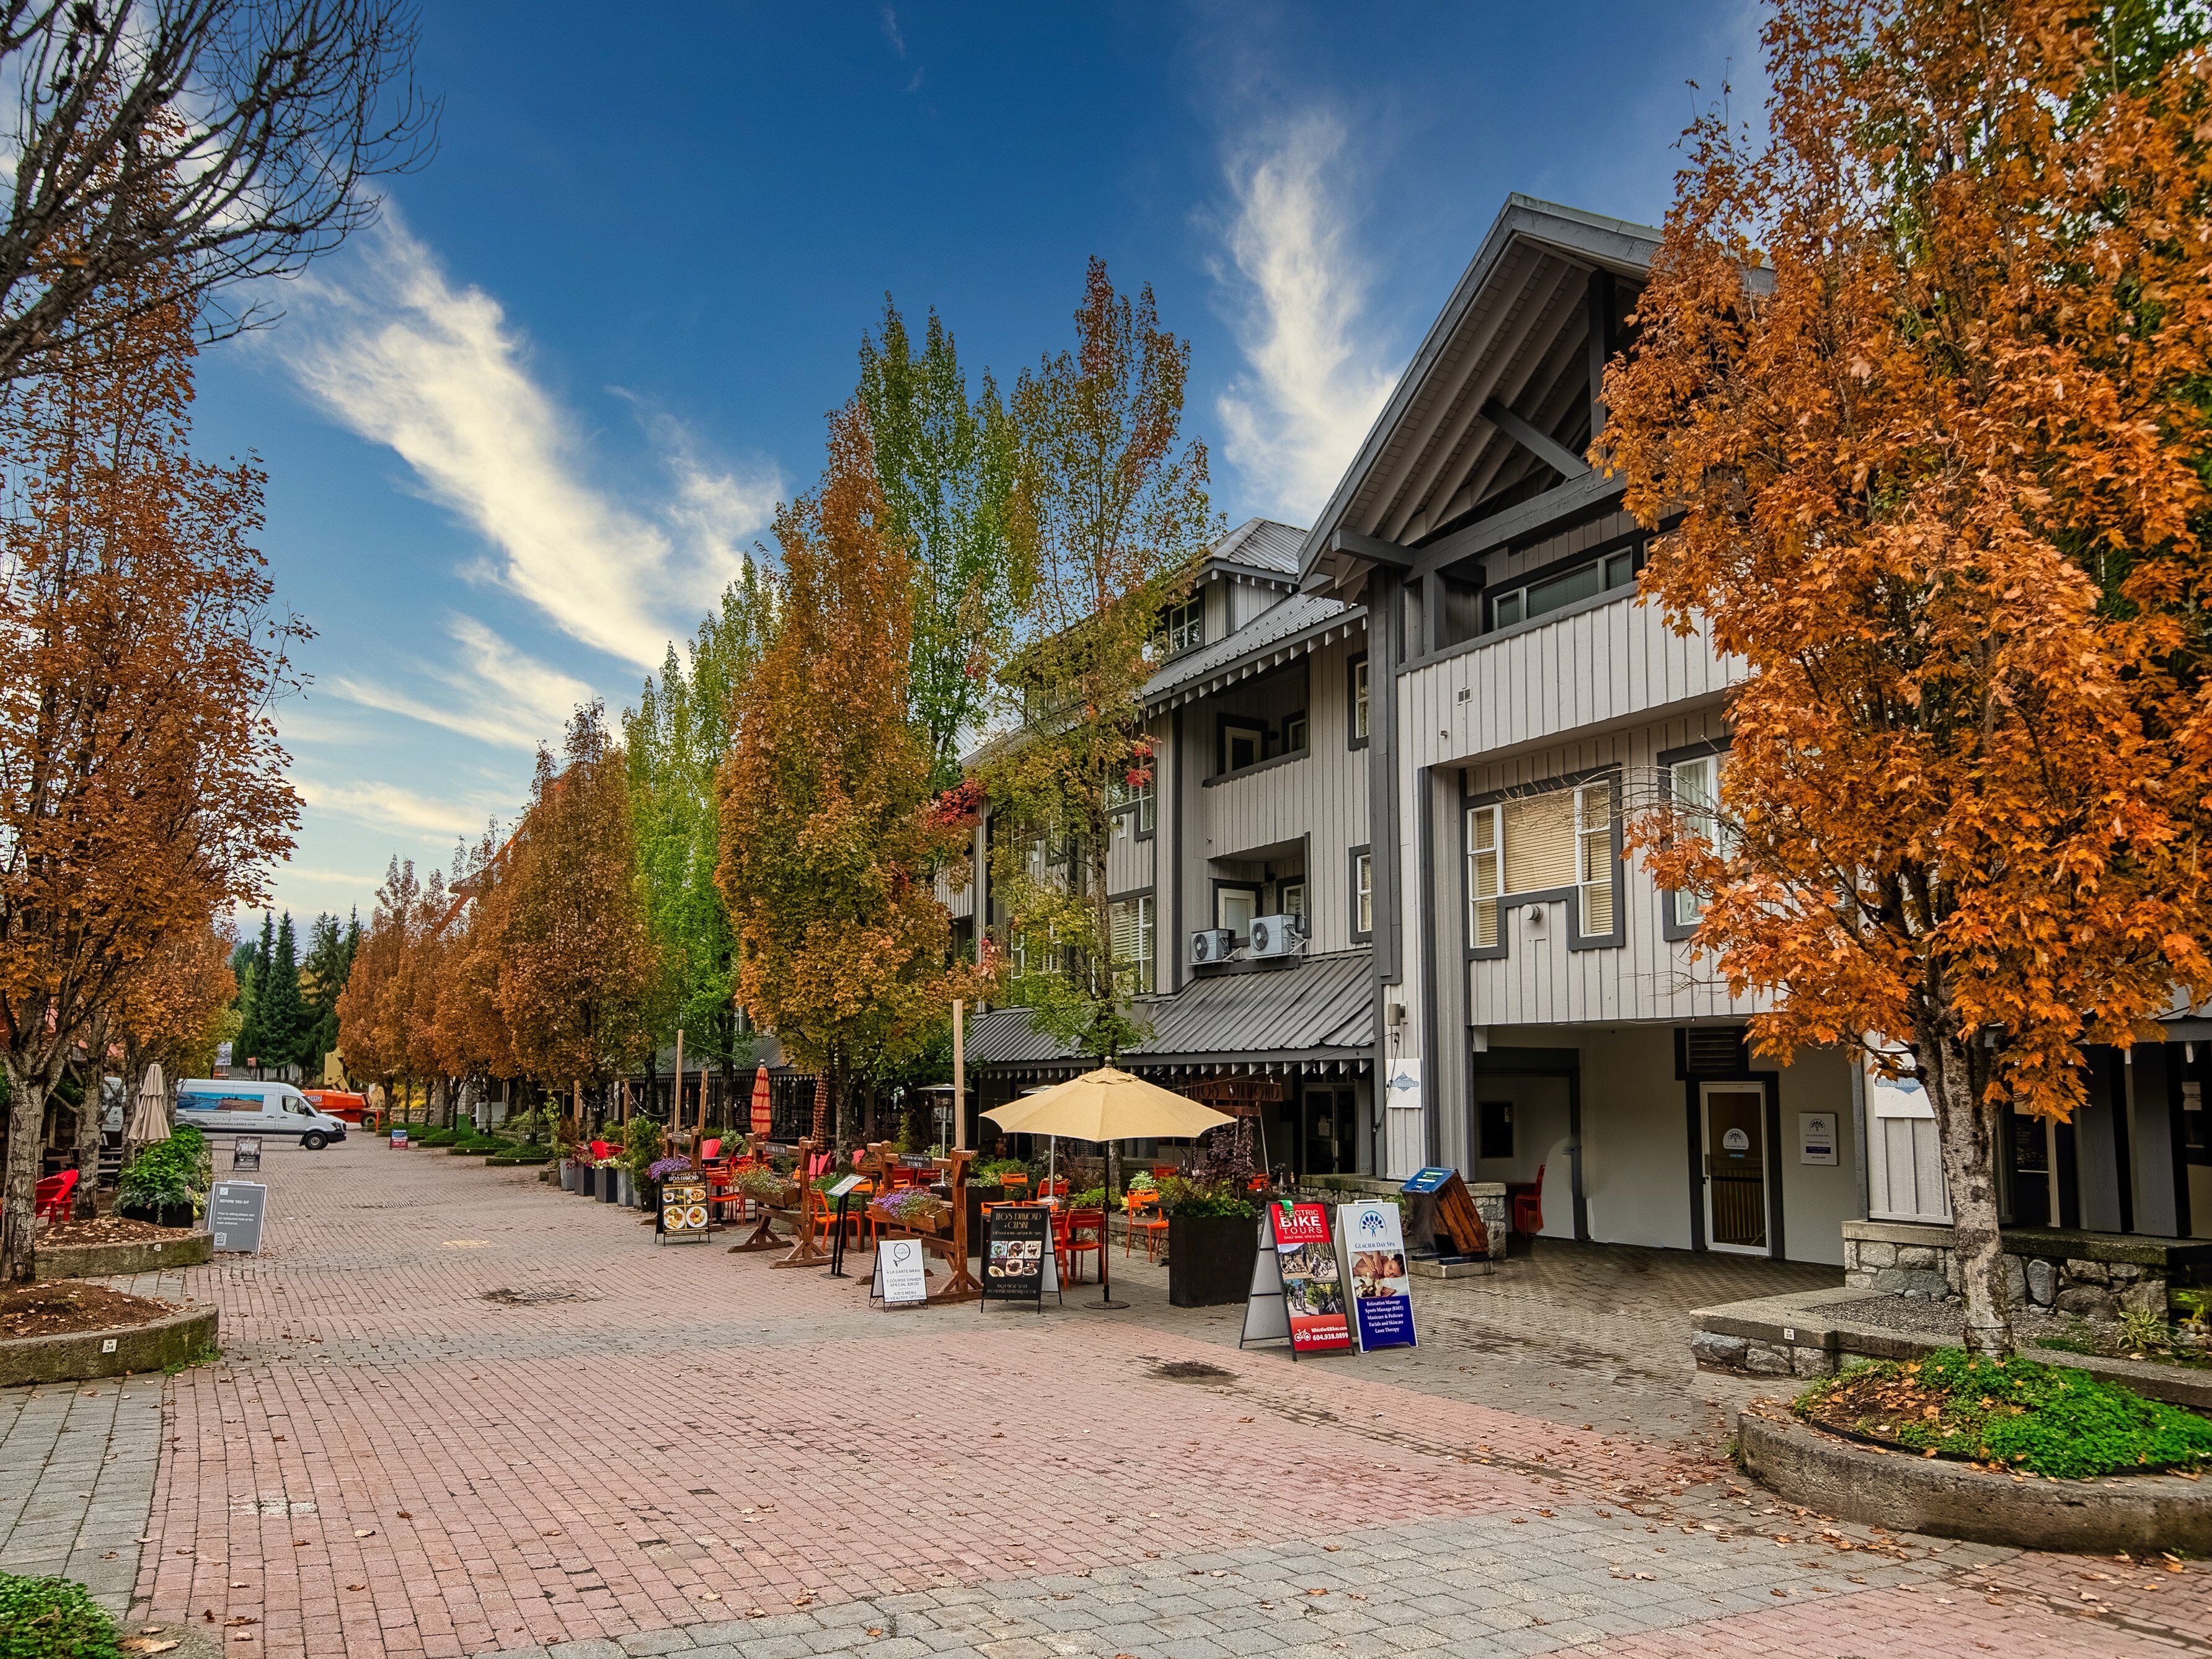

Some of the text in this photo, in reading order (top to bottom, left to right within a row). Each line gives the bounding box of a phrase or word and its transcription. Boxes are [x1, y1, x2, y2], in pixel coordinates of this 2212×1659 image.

[1280, 1216, 1321, 1228] BIKE
[1282, 1226, 1323, 1235] TOURS
[1312, 1332, 1348, 1341] 604.938.0899
